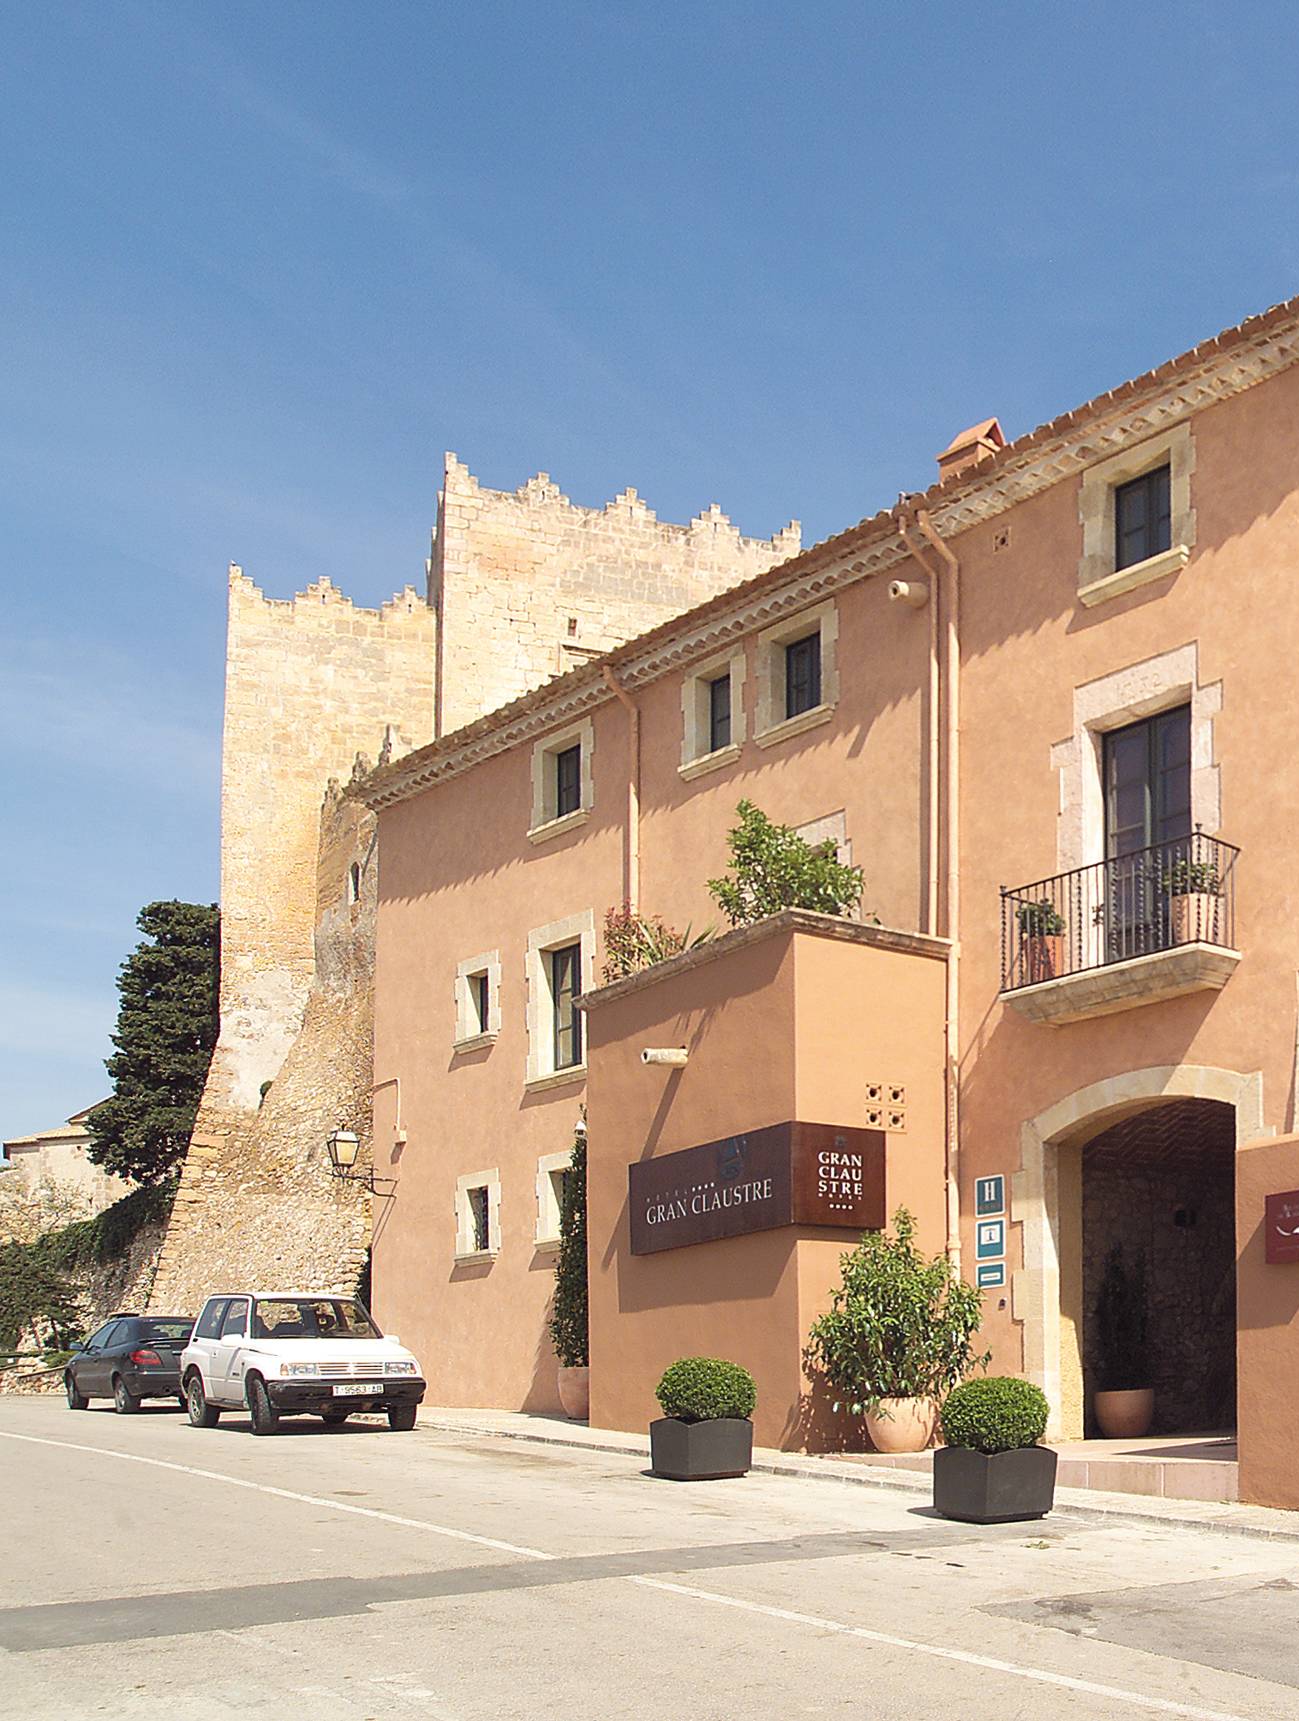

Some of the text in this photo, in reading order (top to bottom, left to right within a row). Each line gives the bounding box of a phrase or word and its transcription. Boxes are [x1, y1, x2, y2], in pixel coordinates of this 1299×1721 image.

[818, 1151, 862, 1167] GRAN
[818, 1165, 862, 1181] CLAU
[818, 1180, 863, 1194] STRE
[983, 1181, 996, 1201] H
[646, 1178, 773, 1225] GRAN CLAUSTRE
